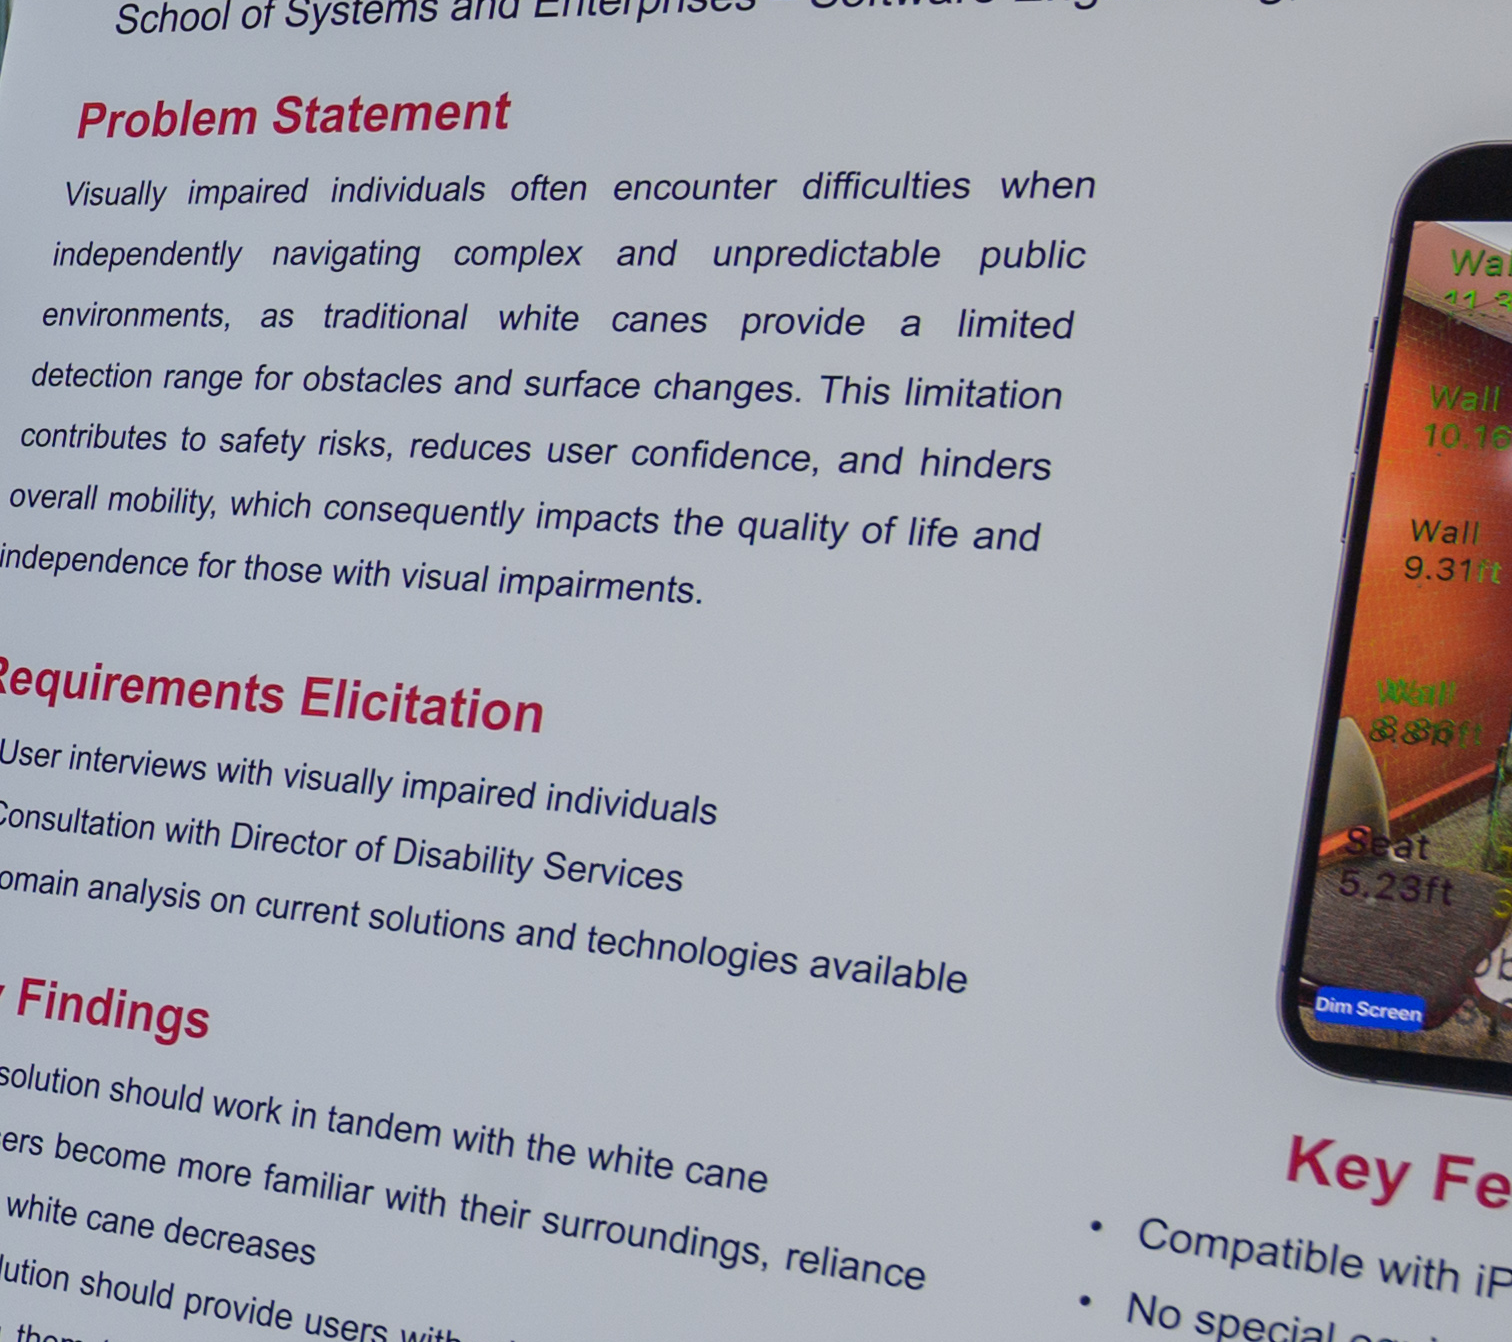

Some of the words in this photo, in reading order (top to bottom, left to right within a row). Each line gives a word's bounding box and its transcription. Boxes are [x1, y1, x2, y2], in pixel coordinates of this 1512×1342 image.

[76, 98, 258, 139] Problem
[272, 91, 512, 135] Statement
[65, 179, 168, 212] Visually
[187, 176, 310, 211] impaired
[330, 174, 486, 203] individuals
[510, 173, 587, 202] often
[612, 173, 778, 201] encounter
[802, 169, 971, 200] difficulties
[1000, 169, 1096, 199] when
[52, 239, 243, 273] independently
[272, 238, 421, 273] navigating
[453, 238, 583, 273] complex
[616, 238, 678, 267] and
[712, 238, 941, 274] unpredictable
[978, 238, 1087, 276] public
[1429, 383, 1501, 413] Wall
[1411, 518, 1481, 546] Wall
[1403, 555, 1503, 585] 9.31ft
[300, 675, 543, 733] Elicitation
[68, 743, 207, 781] interviews
[216, 756, 273, 787] with
[283, 761, 394, 804] visually
[401, 770, 537, 810] impaired
[545, 782, 718, 826] individuals
[164, 817, 221, 847] with
[229, 821, 348, 859] Director
[354, 834, 388, 863] of
[392, 836, 535, 885] Disability
[543, 850, 683, 893] Services
[1344, 827, 1431, 861] Seat
[1338, 868, 1455, 907] 5.23ft
[87, 877, 201, 913] analysis
[209, 891, 246, 916] on
[255, 896, 360, 928] current
[367, 904, 506, 943] solutions
[515, 921, 577, 951] and
[587, 925, 798, 978] technologies
[809, 954, 968, 994] available
[16, 976, 210, 1046] Findings
[1315, 996, 1353, 1017] Dim
[1356, 1001, 1424, 1024] Screen
[1287, 1134, 1412, 1207] Key
[1433, 1153, 1512, 1209] Fe
[53, 1131, 166, 1175] become
[176, 1156, 252, 1188] more
[263, 1162, 375, 1206] familiar
[385, 1184, 446, 1217] with
[460, 1192, 532, 1230] their
[541, 1211, 768, 1272] surroundings,
[785, 1245, 926, 1291] reliance
[1138, 1217, 1364, 1279] Compatible
[1378, 1255, 1460, 1293] with
[1126, 1291, 1182, 1330] No
